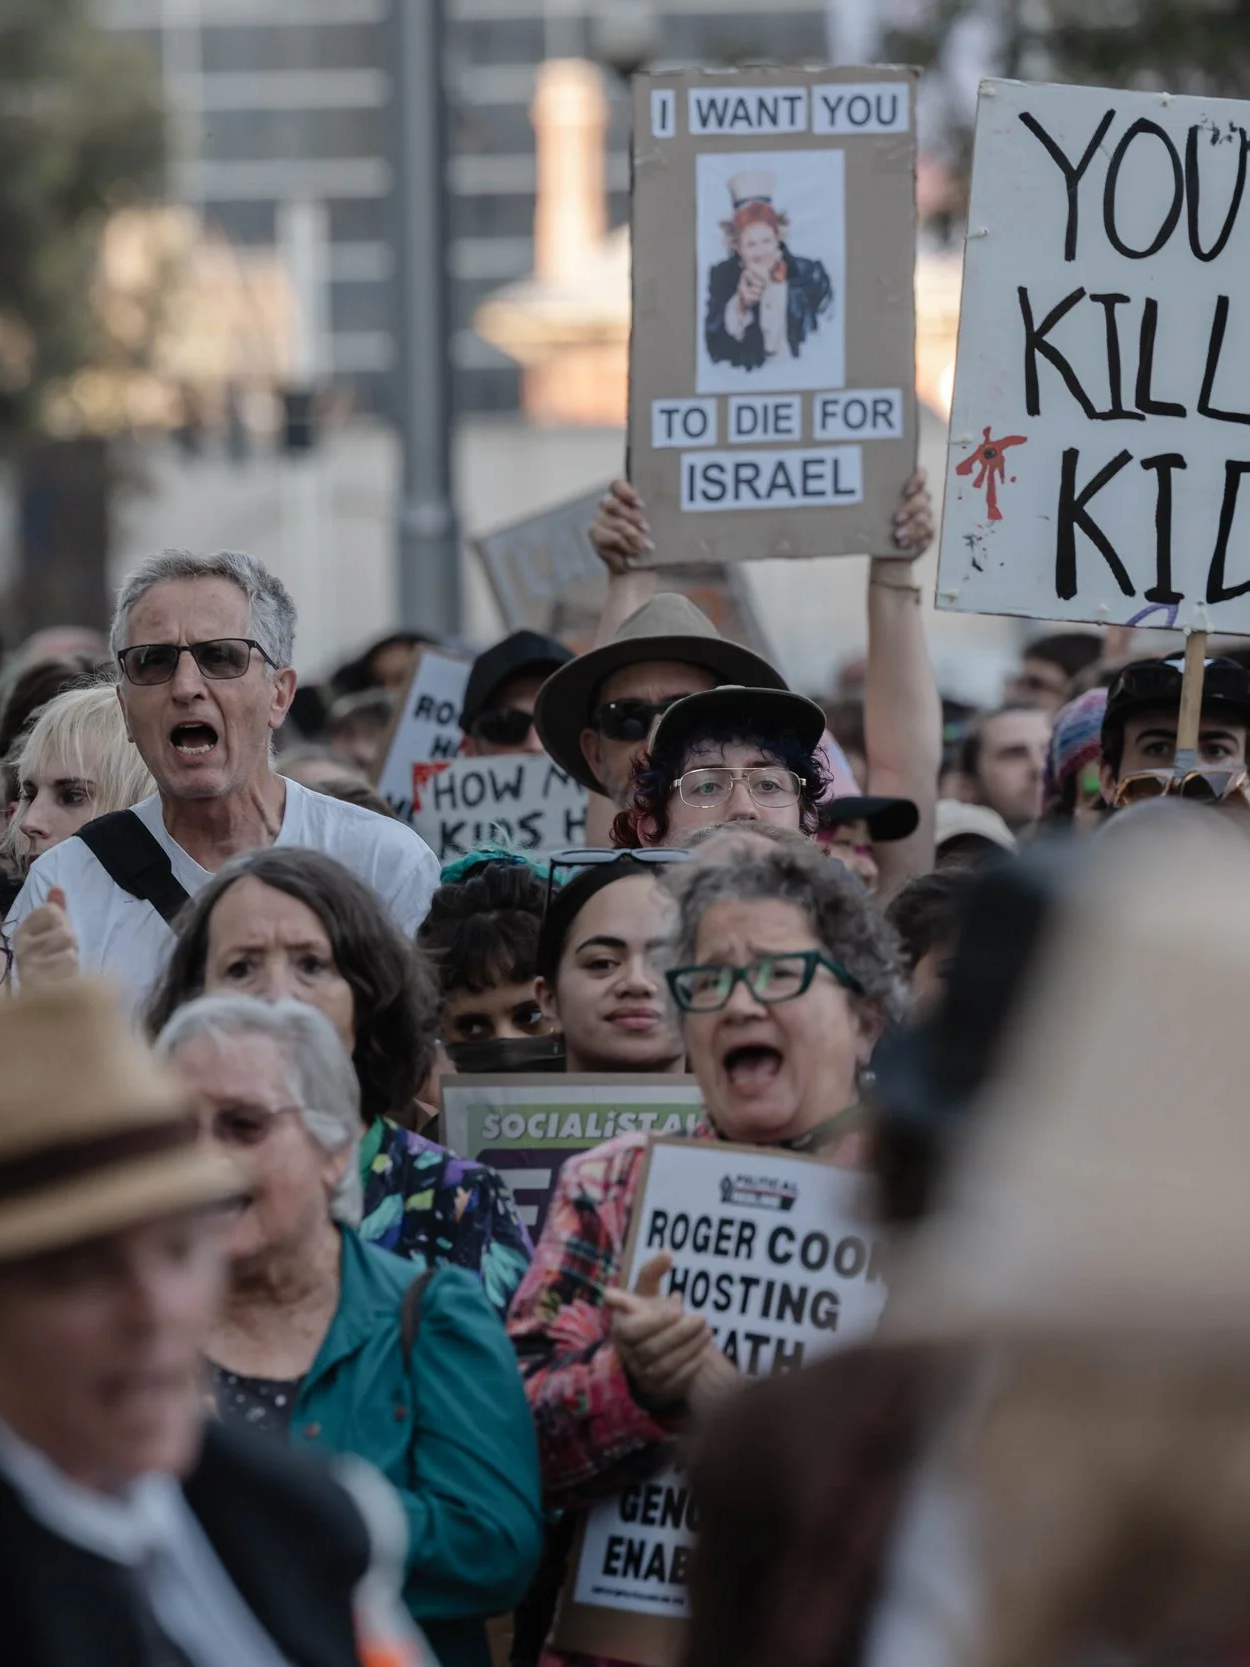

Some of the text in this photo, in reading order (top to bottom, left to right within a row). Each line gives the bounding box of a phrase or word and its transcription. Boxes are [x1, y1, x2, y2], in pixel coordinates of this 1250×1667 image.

[660, 94, 898, 130] I WANT YOU
[1018, 108, 1249, 263] YOU
[660, 398, 896, 440] TO DIE FOR
[687, 456, 856, 503] ISRAEL
[432, 764, 524, 812] HOW
[647, 1209, 757, 1260] ROGER
[668, 1265, 842, 1333] HOSTING
